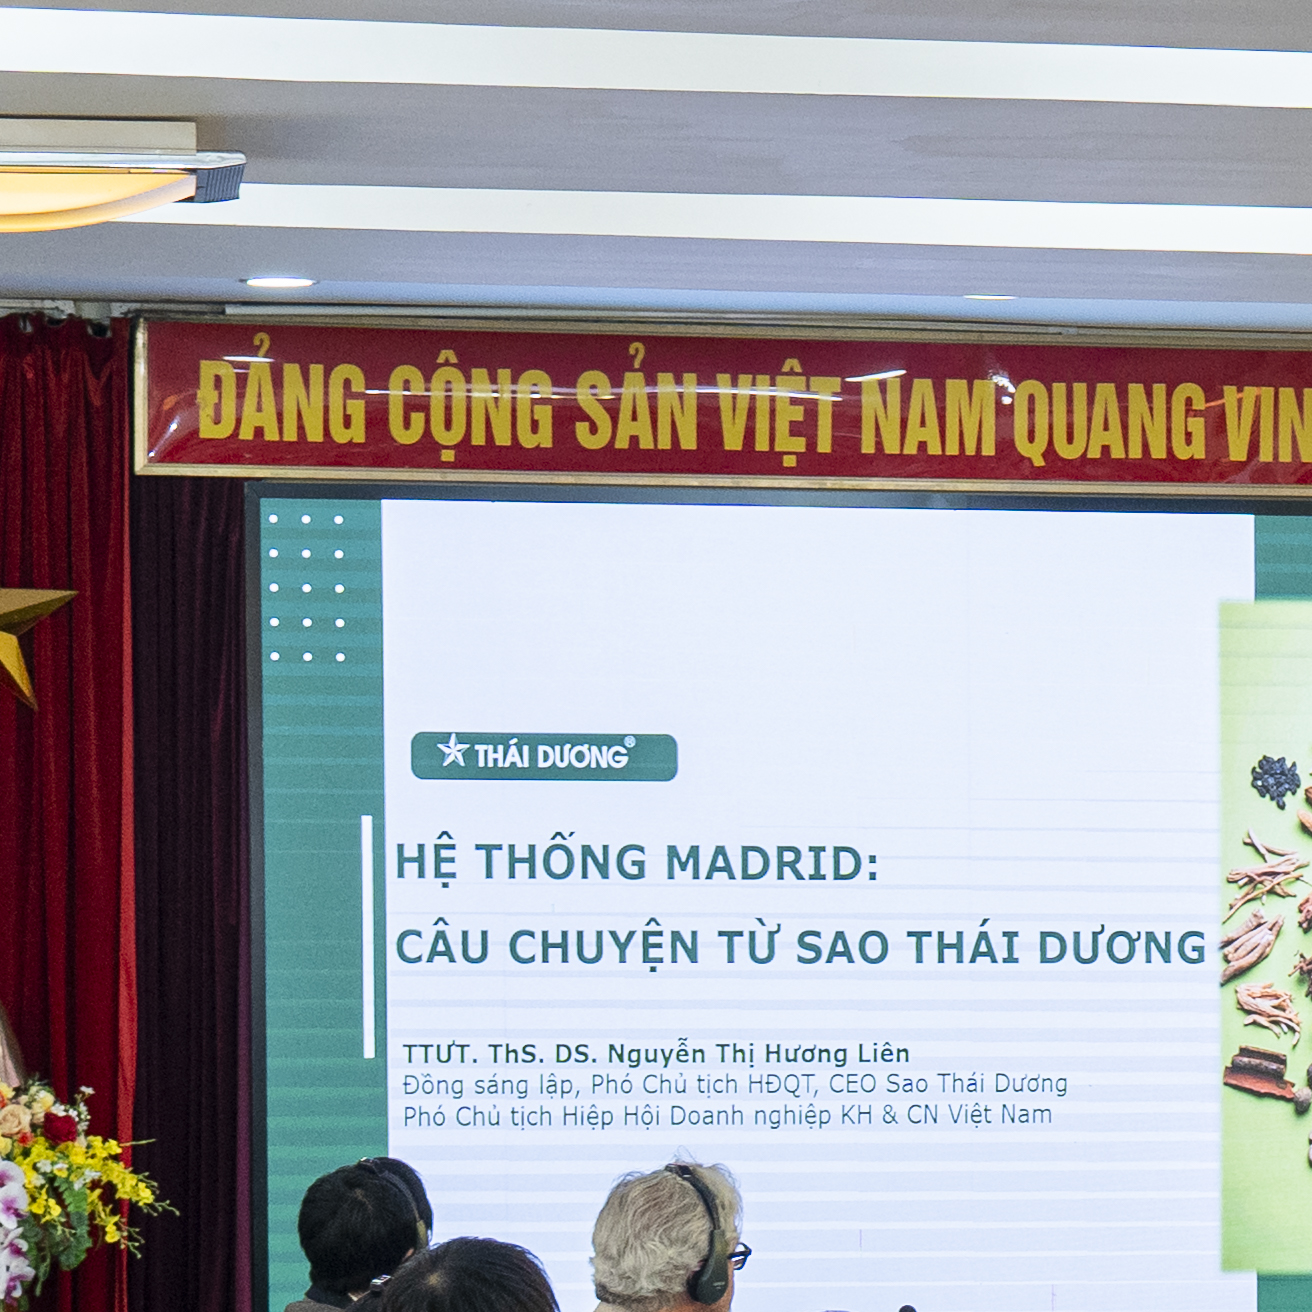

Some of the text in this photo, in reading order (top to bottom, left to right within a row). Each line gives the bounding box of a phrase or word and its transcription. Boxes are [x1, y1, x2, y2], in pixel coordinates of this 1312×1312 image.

[197, 333, 366, 444] ĐẢNG
[388, 349, 553, 462] CỘNG
[575, 342, 698, 451] SẢN
[720, 358, 842, 467] VIỆT
[861, 376, 996, 456] NAM
[1014, 379, 1207, 467] QUANG
[474, 737, 530, 768] THÁI
[396, 831, 877, 889] HỆ THỐNG MADRID:
[396, 917, 1205, 973] CÂU CHUYỆN TỪ SAO THÁI DƯƠNG
[403, 1038, 910, 1068] TTƯT. ThS. DS. Nguyễn Thị Hương Liên
[402, 1072, 1068, 1100] Đồng sáng lập, Phó Chủ tịch HĐQT, CEO Sao Thái Dương
[404, 1103, 1052, 1131] Phó Chủ tịch Hiệp Hội Doanh nghiệp KH & CN Việt Nam
